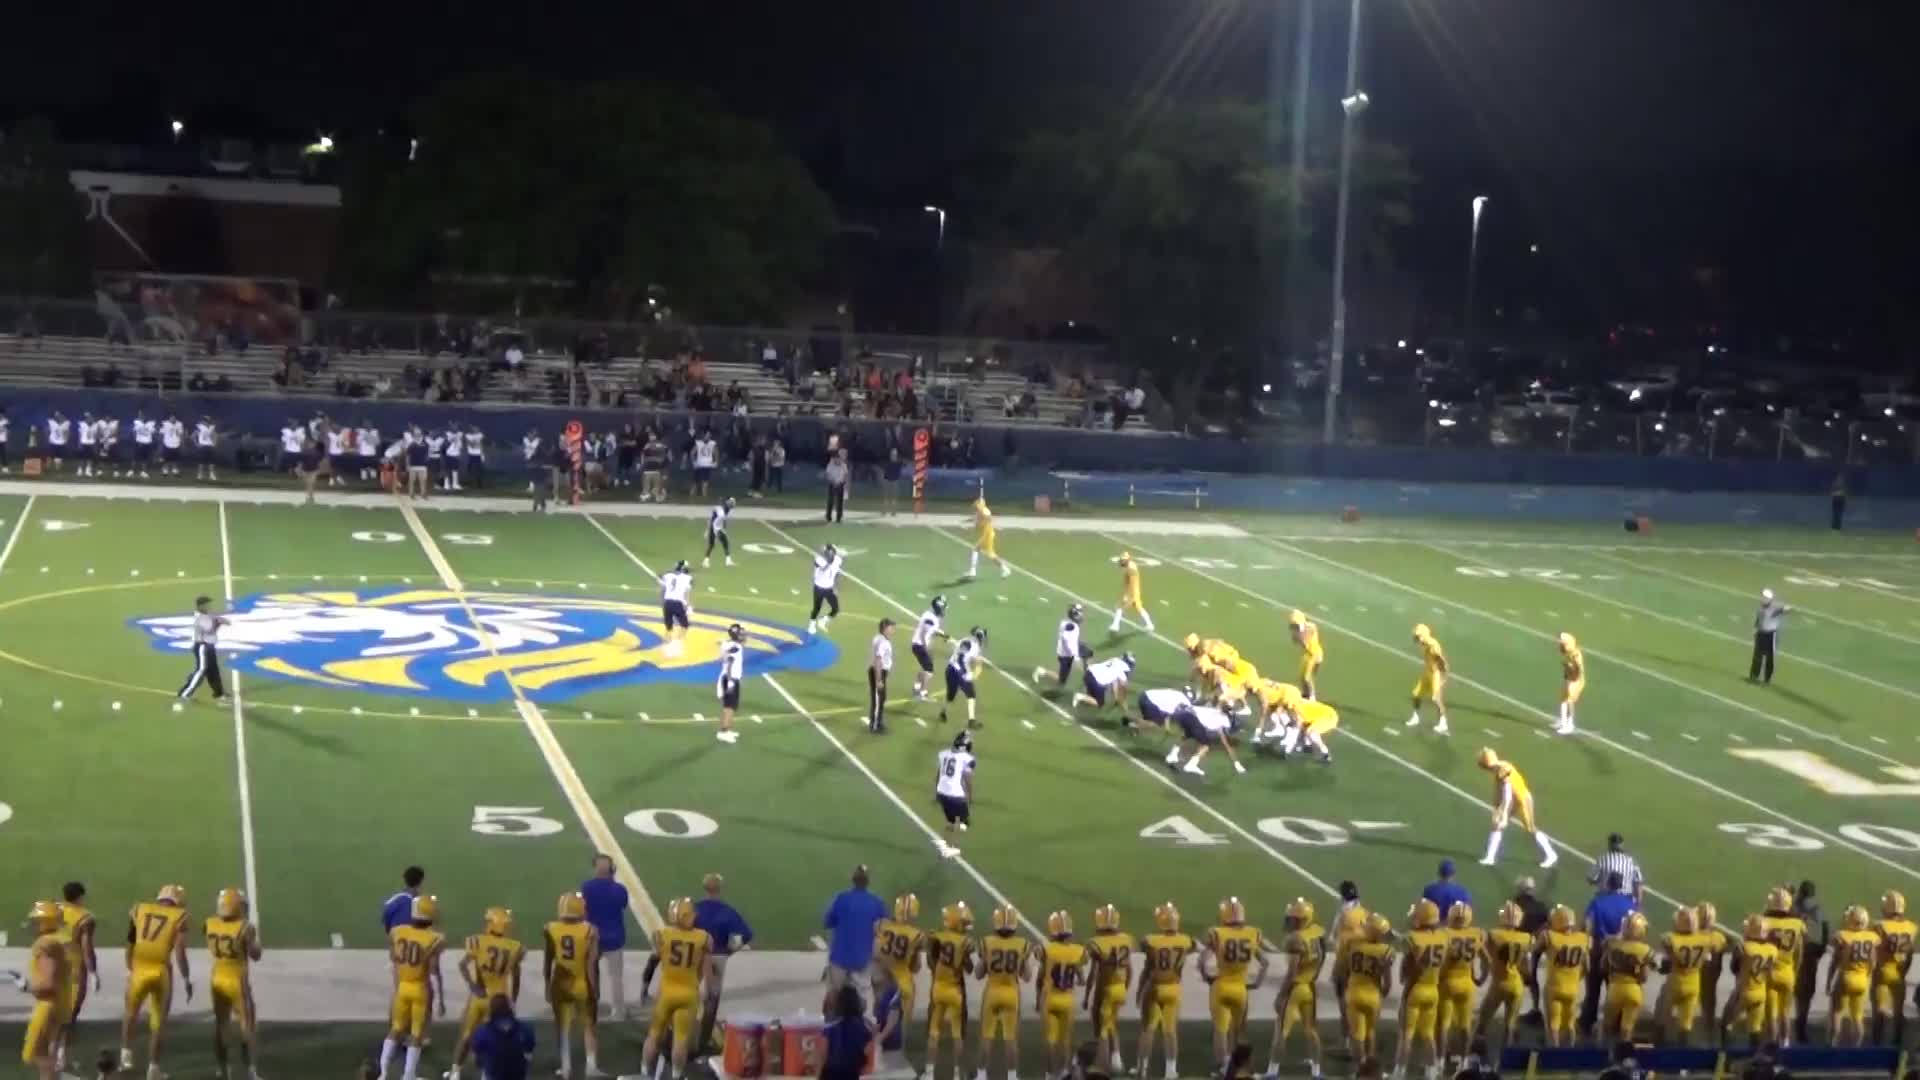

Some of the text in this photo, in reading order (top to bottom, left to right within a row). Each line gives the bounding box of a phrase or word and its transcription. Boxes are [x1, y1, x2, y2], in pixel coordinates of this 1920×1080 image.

[943, 757, 956, 778] 16
[143, 912, 168, 942] 17
[560, 935, 575, 960] 9
[670, 940, 696, 968] 51
[1224, 938, 1251, 962] 85
